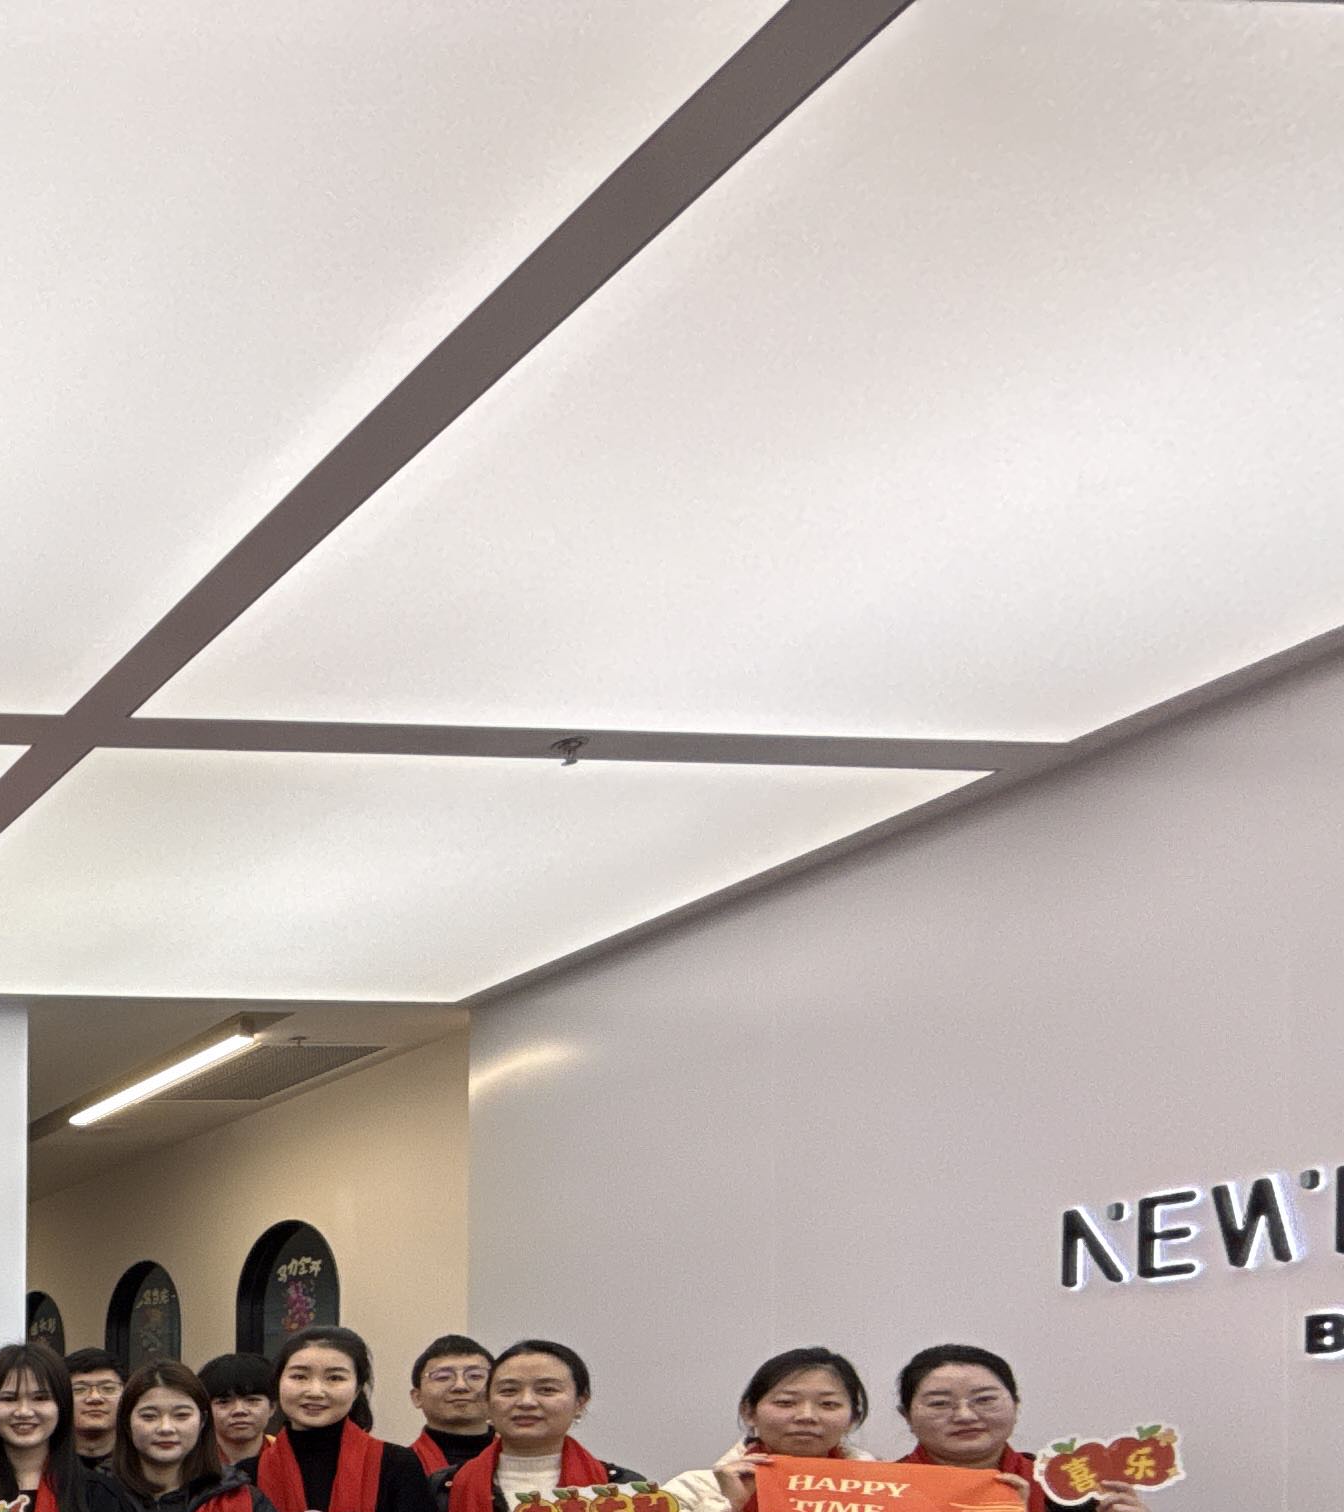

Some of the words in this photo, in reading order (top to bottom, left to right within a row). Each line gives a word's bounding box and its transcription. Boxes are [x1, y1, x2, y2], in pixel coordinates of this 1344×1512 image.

[1062, 1165, 1344, 1288] NEW
[787, 1474, 910, 1498] HAPPY
[1061, 1449, 1157, 1492] 喜乐
